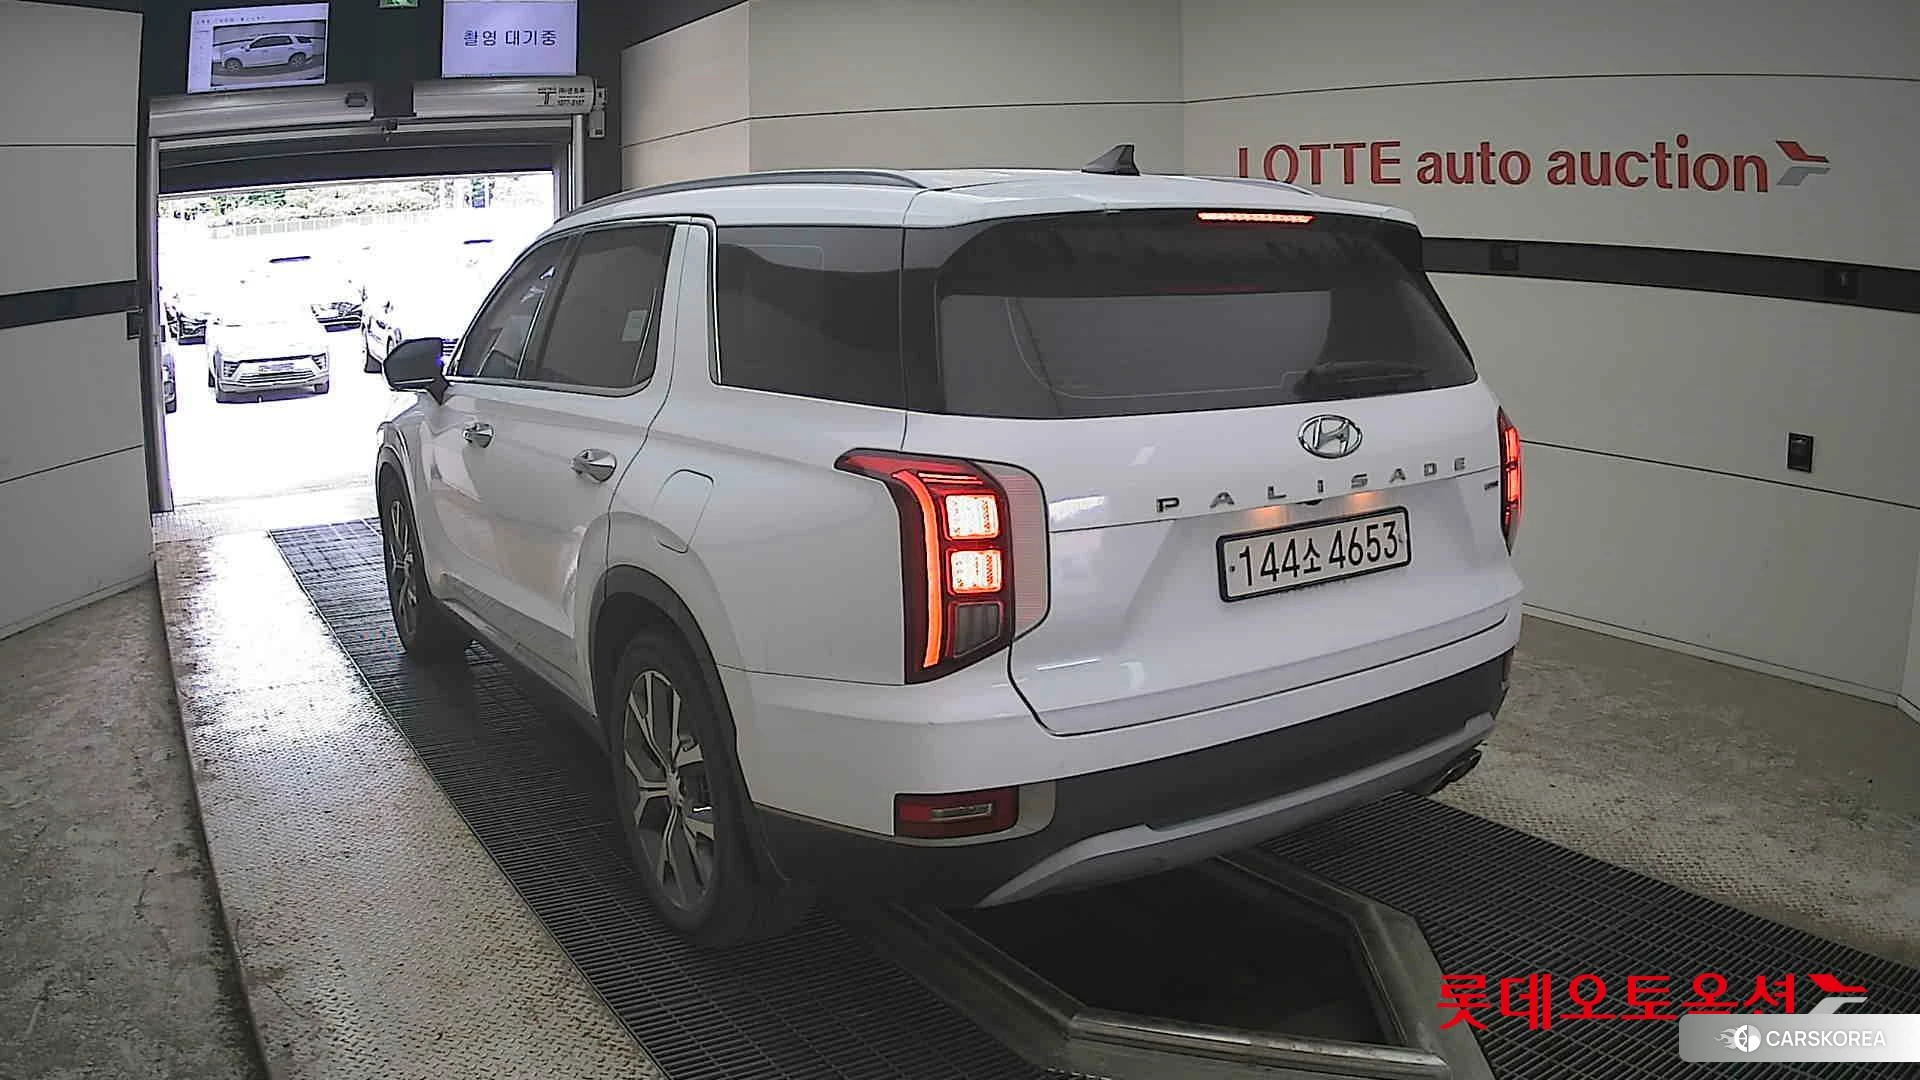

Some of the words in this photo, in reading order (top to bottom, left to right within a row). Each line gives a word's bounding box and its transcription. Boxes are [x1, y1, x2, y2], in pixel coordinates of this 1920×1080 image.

[463, 30, 497, 47] 촬영
[505, 29, 557, 47] 대기중
[1416, 141, 1531, 186] auto
[1546, 134, 1769, 193] auction
[1156, 457, 1467, 513] PALISADE
[1239, 537, 1322, 587] 144소
[1328, 520, 1399, 570] 4653
